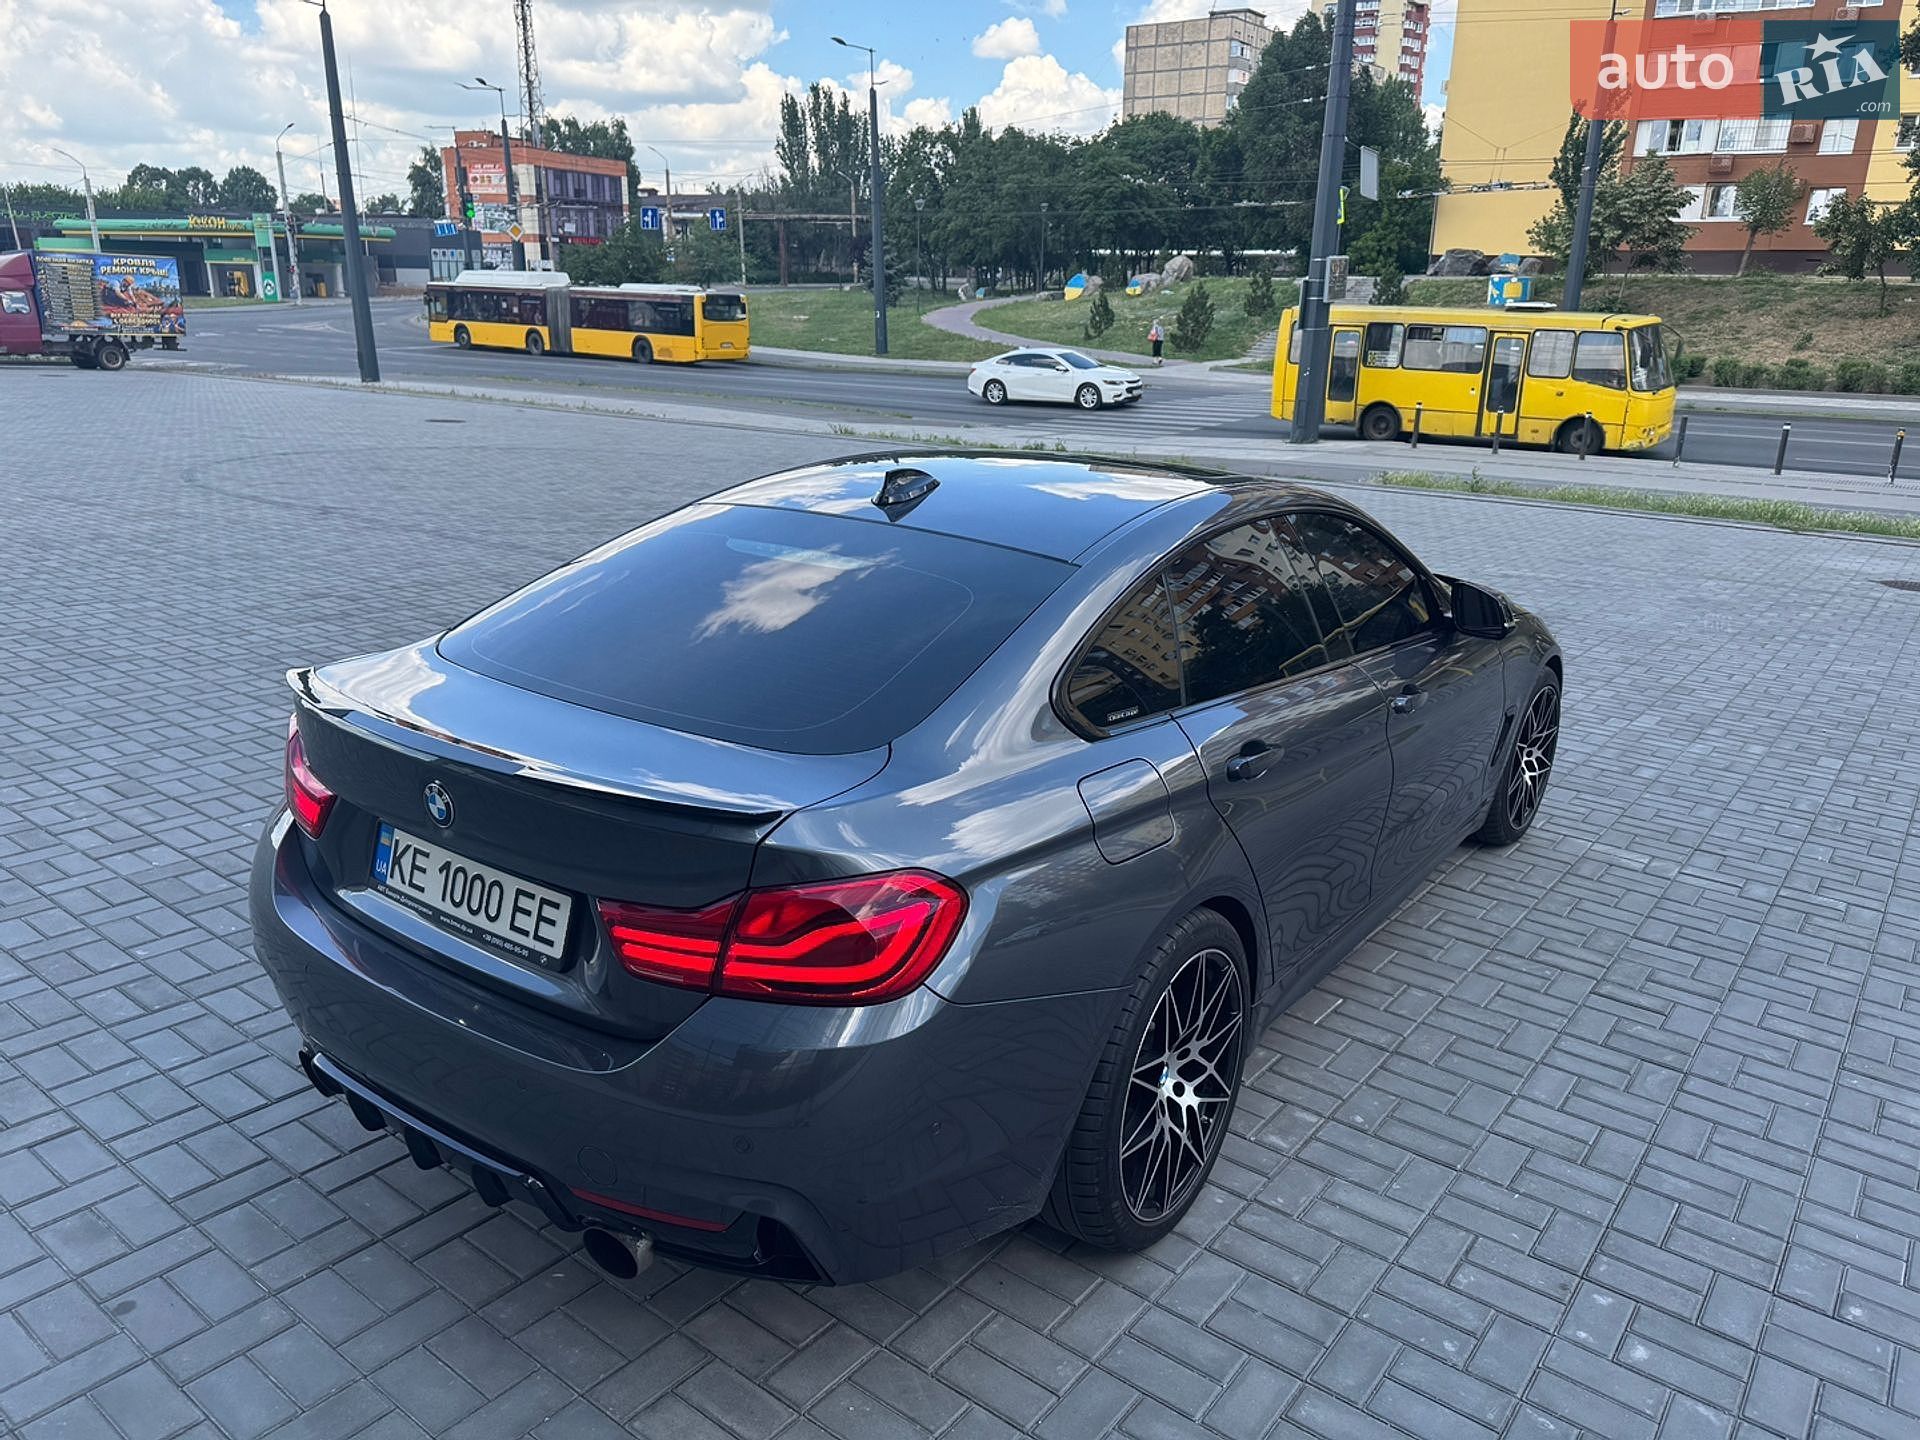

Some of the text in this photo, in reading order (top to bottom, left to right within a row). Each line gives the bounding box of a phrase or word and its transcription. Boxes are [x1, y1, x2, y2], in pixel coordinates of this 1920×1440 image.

[113, 257, 156, 267] КРОВЛЯ
[100, 265, 138, 275] РЕМОНТ
[375, 859, 388, 876] UA
[389, 837, 430, 893] KE
[438, 860, 504, 923] 1000
[509, 887, 561, 947] EE
